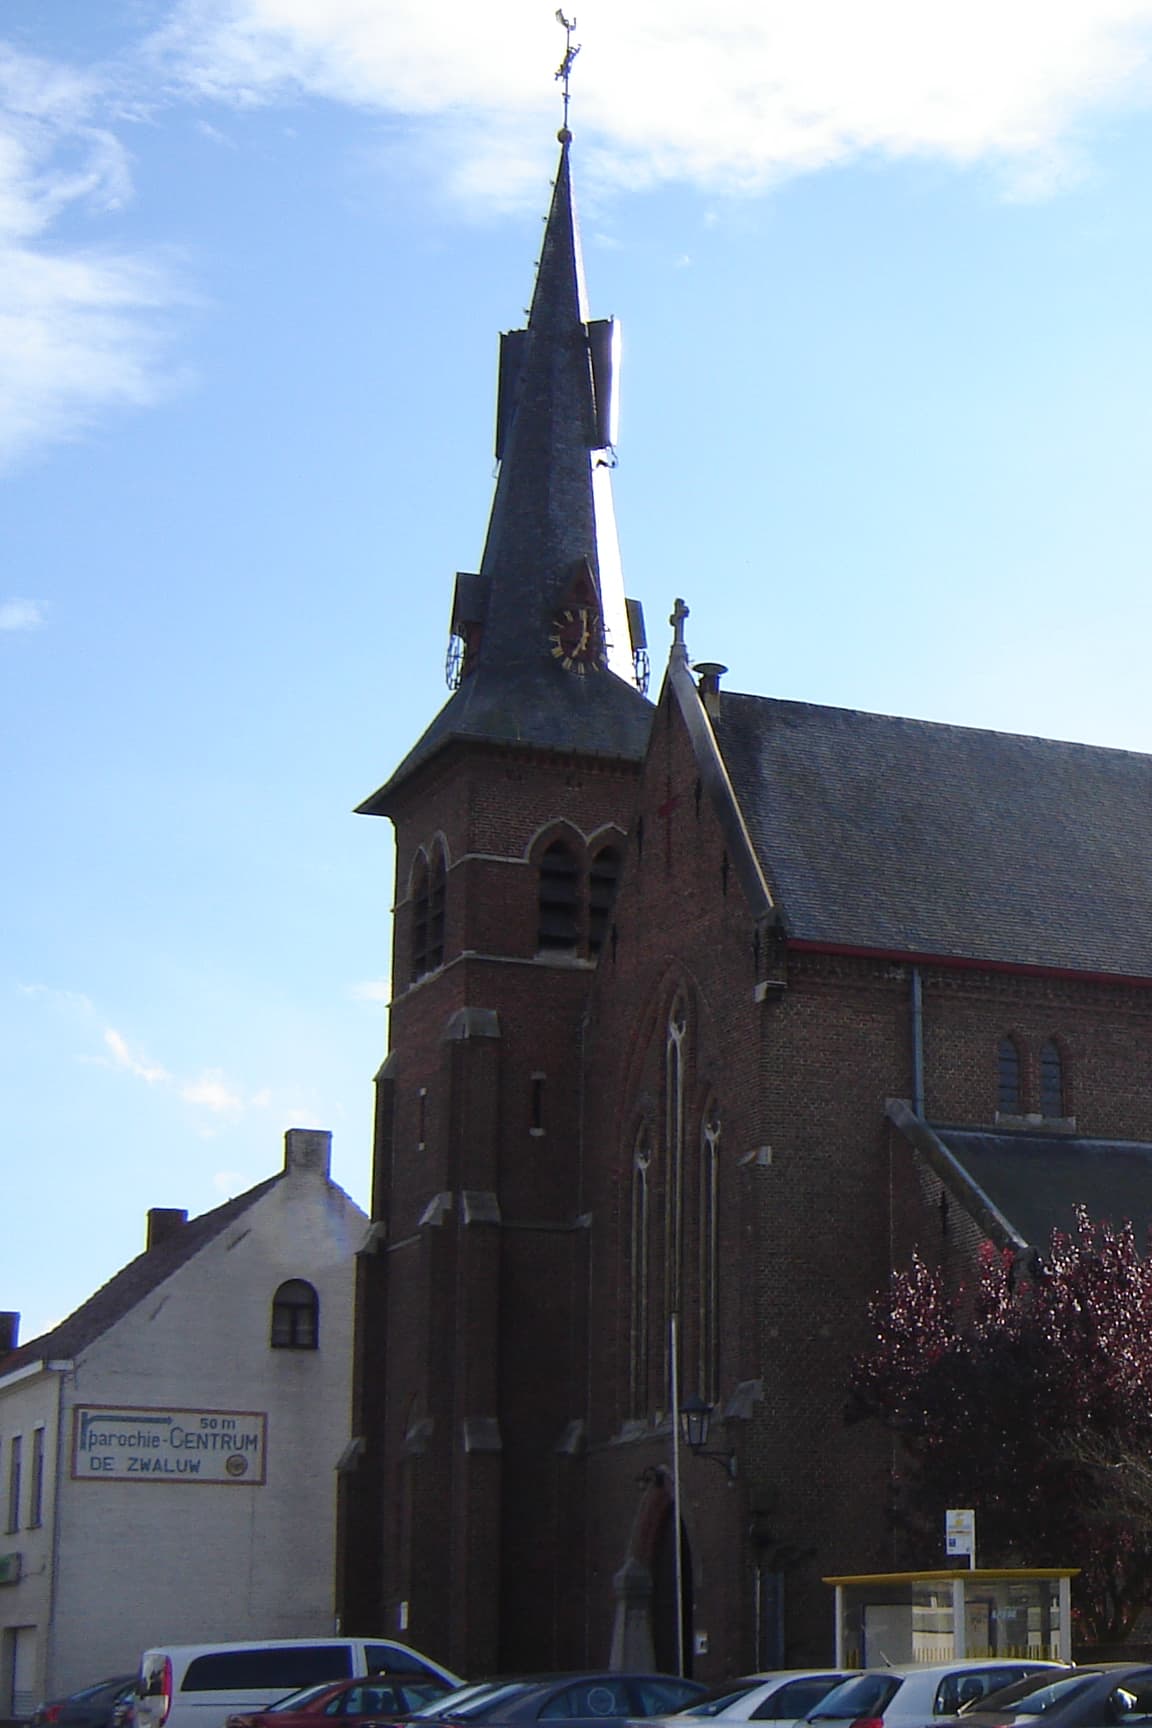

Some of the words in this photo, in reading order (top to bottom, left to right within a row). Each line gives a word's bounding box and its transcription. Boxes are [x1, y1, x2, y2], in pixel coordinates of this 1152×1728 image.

[200, 1418, 217, 1430] 50
[222, 1419, 236, 1430] m
[90, 1457, 115, 1471] DE
[127, 1457, 201, 1473] ZWALUW
